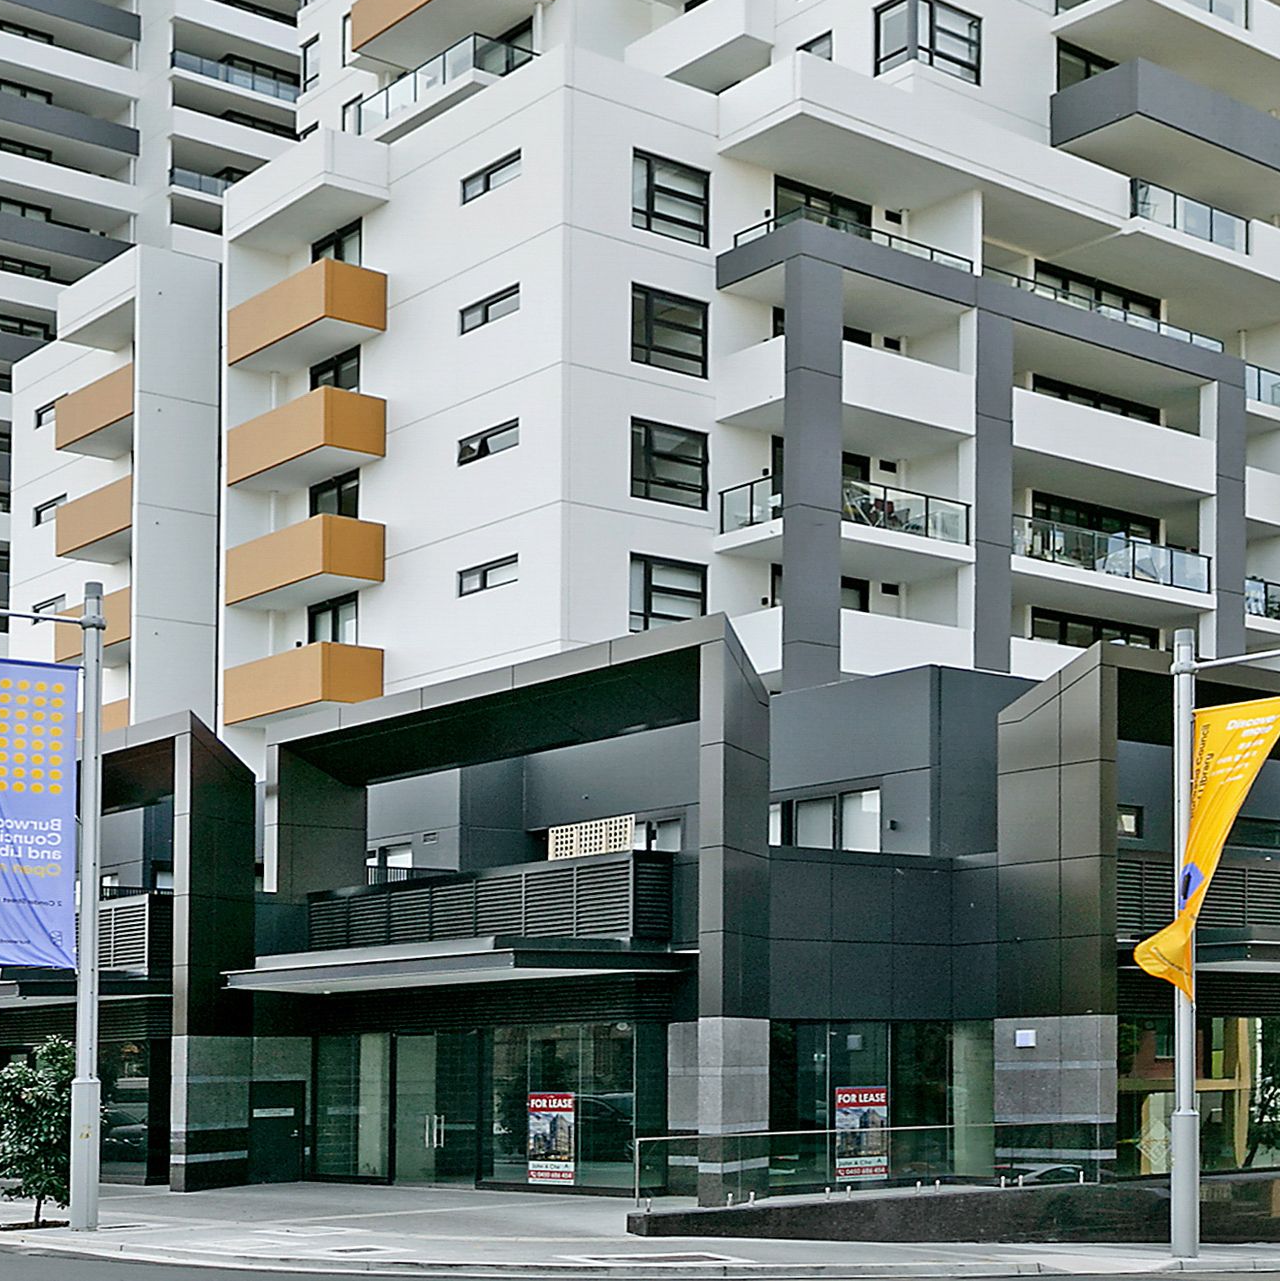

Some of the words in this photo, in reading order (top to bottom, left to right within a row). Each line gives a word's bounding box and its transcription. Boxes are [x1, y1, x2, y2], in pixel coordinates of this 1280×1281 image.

[838, 1093, 857, 1103] FOR
[859, 1092, 886, 1103] LEASE
[530, 1099, 548, 1108] FOR
[549, 1098, 574, 1108] LEASE
